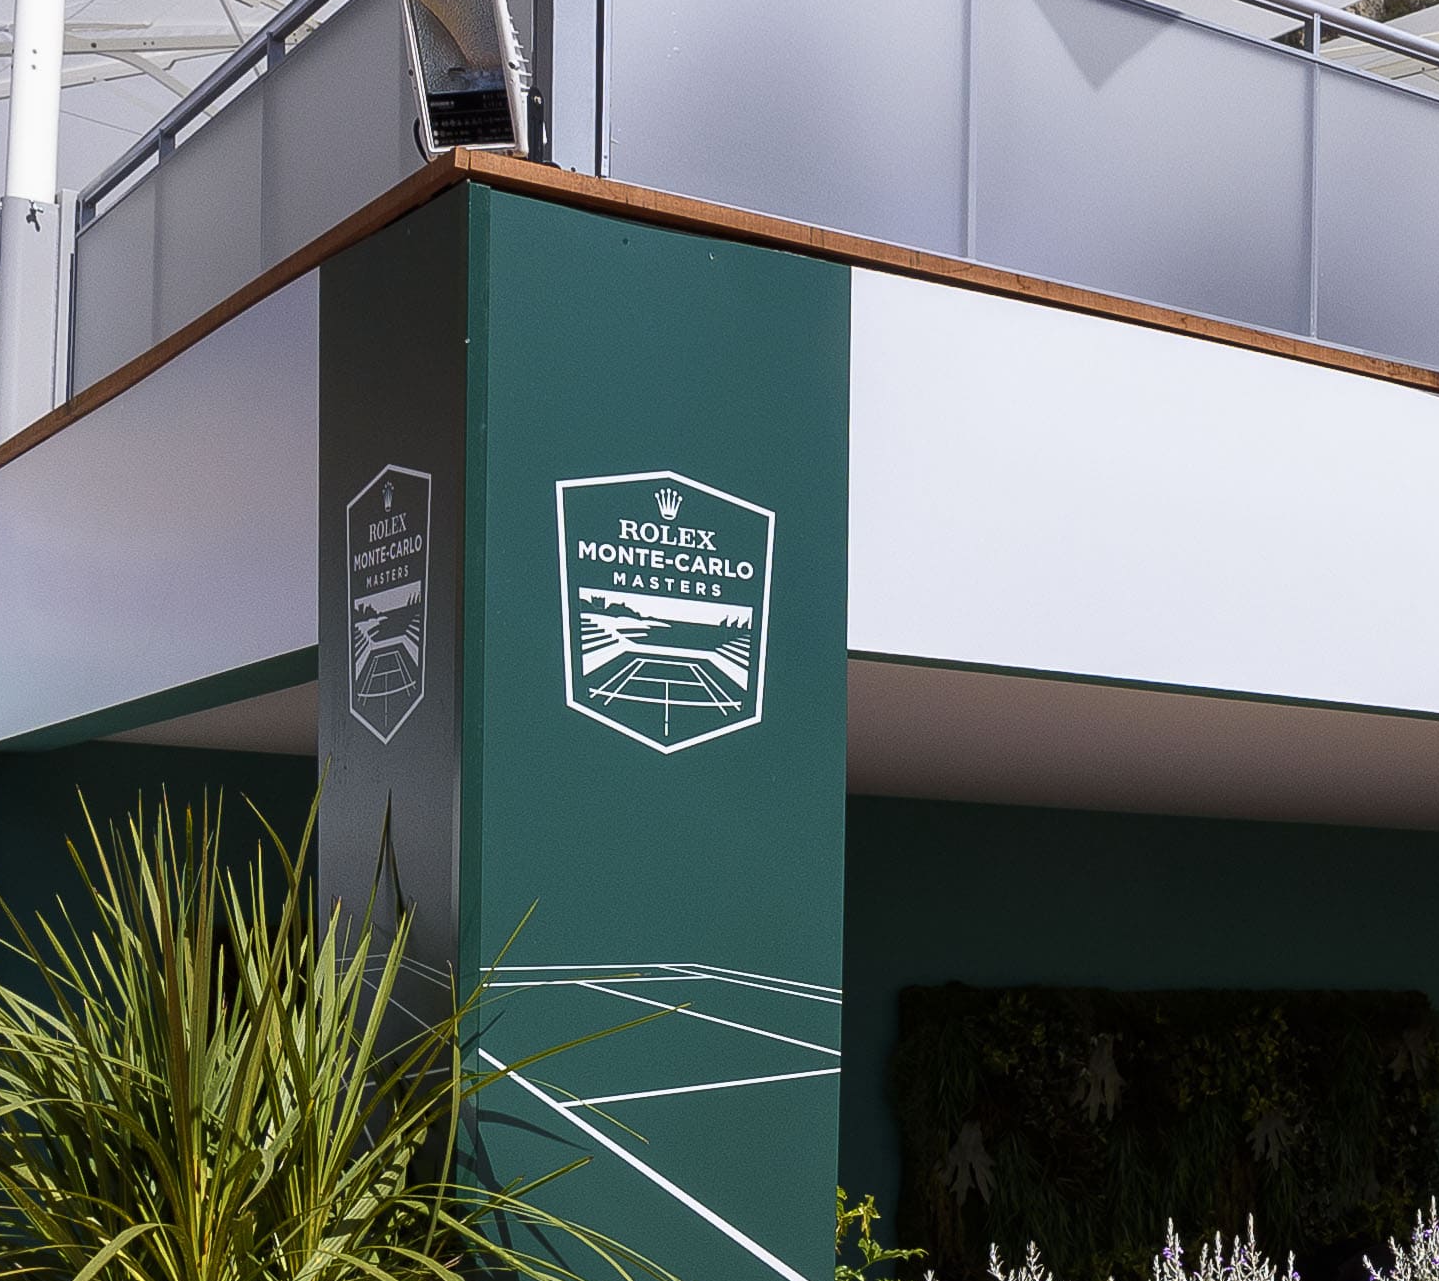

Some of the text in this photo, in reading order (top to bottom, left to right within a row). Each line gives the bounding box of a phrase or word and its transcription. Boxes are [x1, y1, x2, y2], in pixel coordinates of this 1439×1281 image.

[369, 512, 407, 542] ROLEX
[618, 518, 717, 551] ROLEX
[354, 534, 423, 572] MONTE-CARLO
[578, 540, 754, 580] MONTE-CARLO
[366, 565, 409, 589] MASTERS
[613, 571, 722, 597] MASTERS
